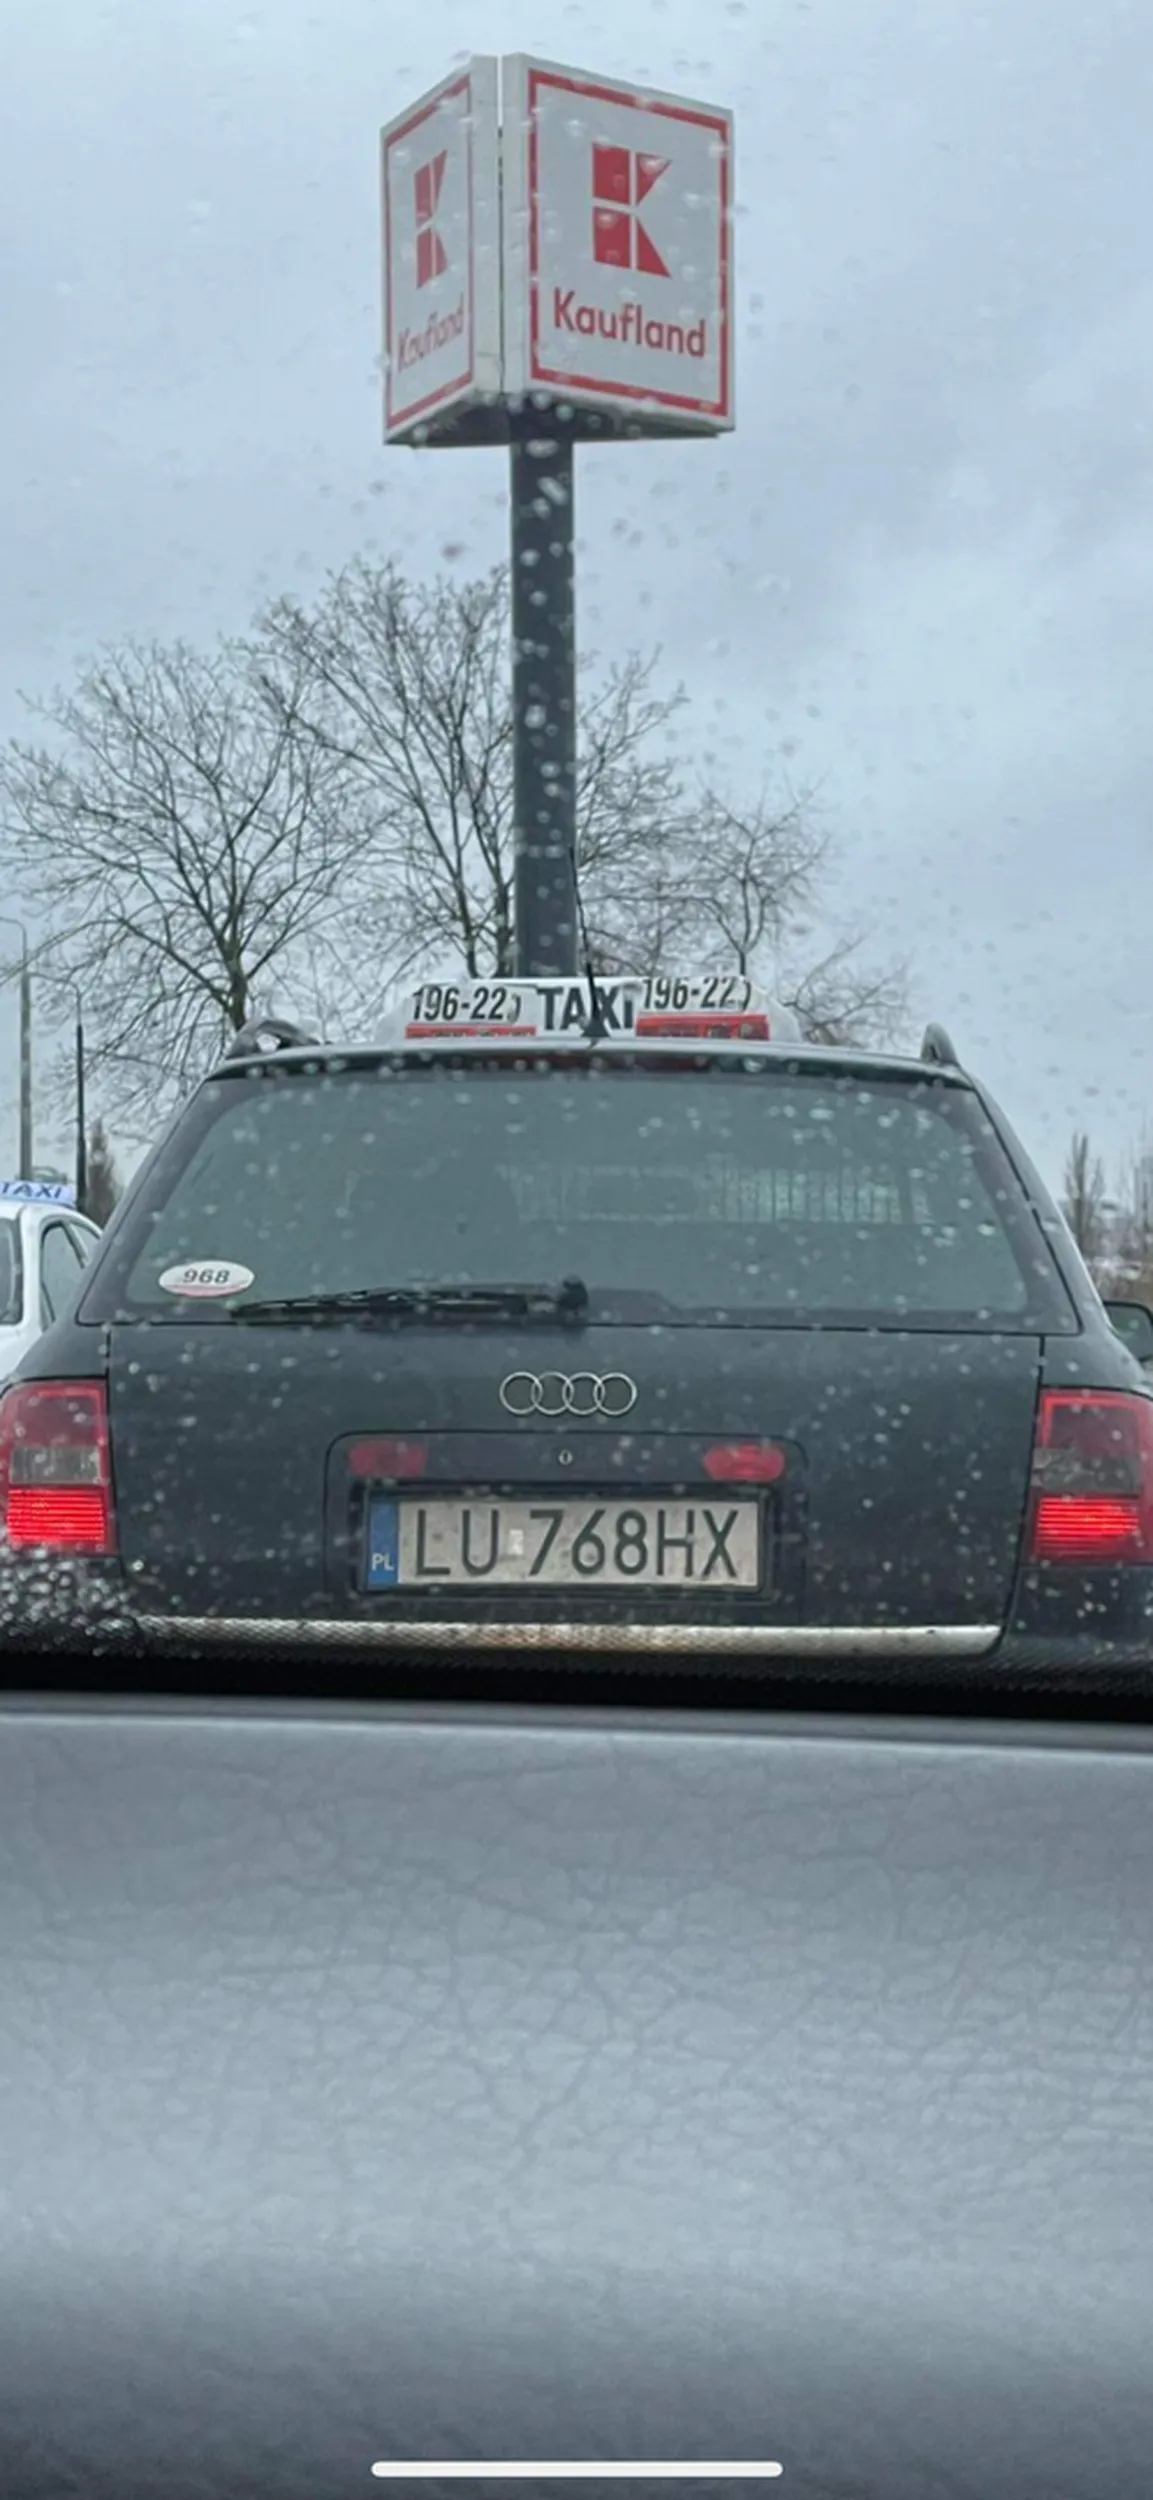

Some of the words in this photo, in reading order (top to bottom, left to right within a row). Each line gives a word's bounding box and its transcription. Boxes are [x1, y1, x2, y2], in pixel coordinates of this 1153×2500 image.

[398, 292, 464, 373] Kaufland
[553, 287, 706, 358] Kaufland
[537, 986, 635, 1031] TAXI
[0, 1182, 63, 1199] TAXI
[183, 1269, 230, 1284] 968
[371, 1554, 394, 1570] PL
[416, 1509, 499, 1576] LU
[529, 1509, 738, 1577] 768HX
